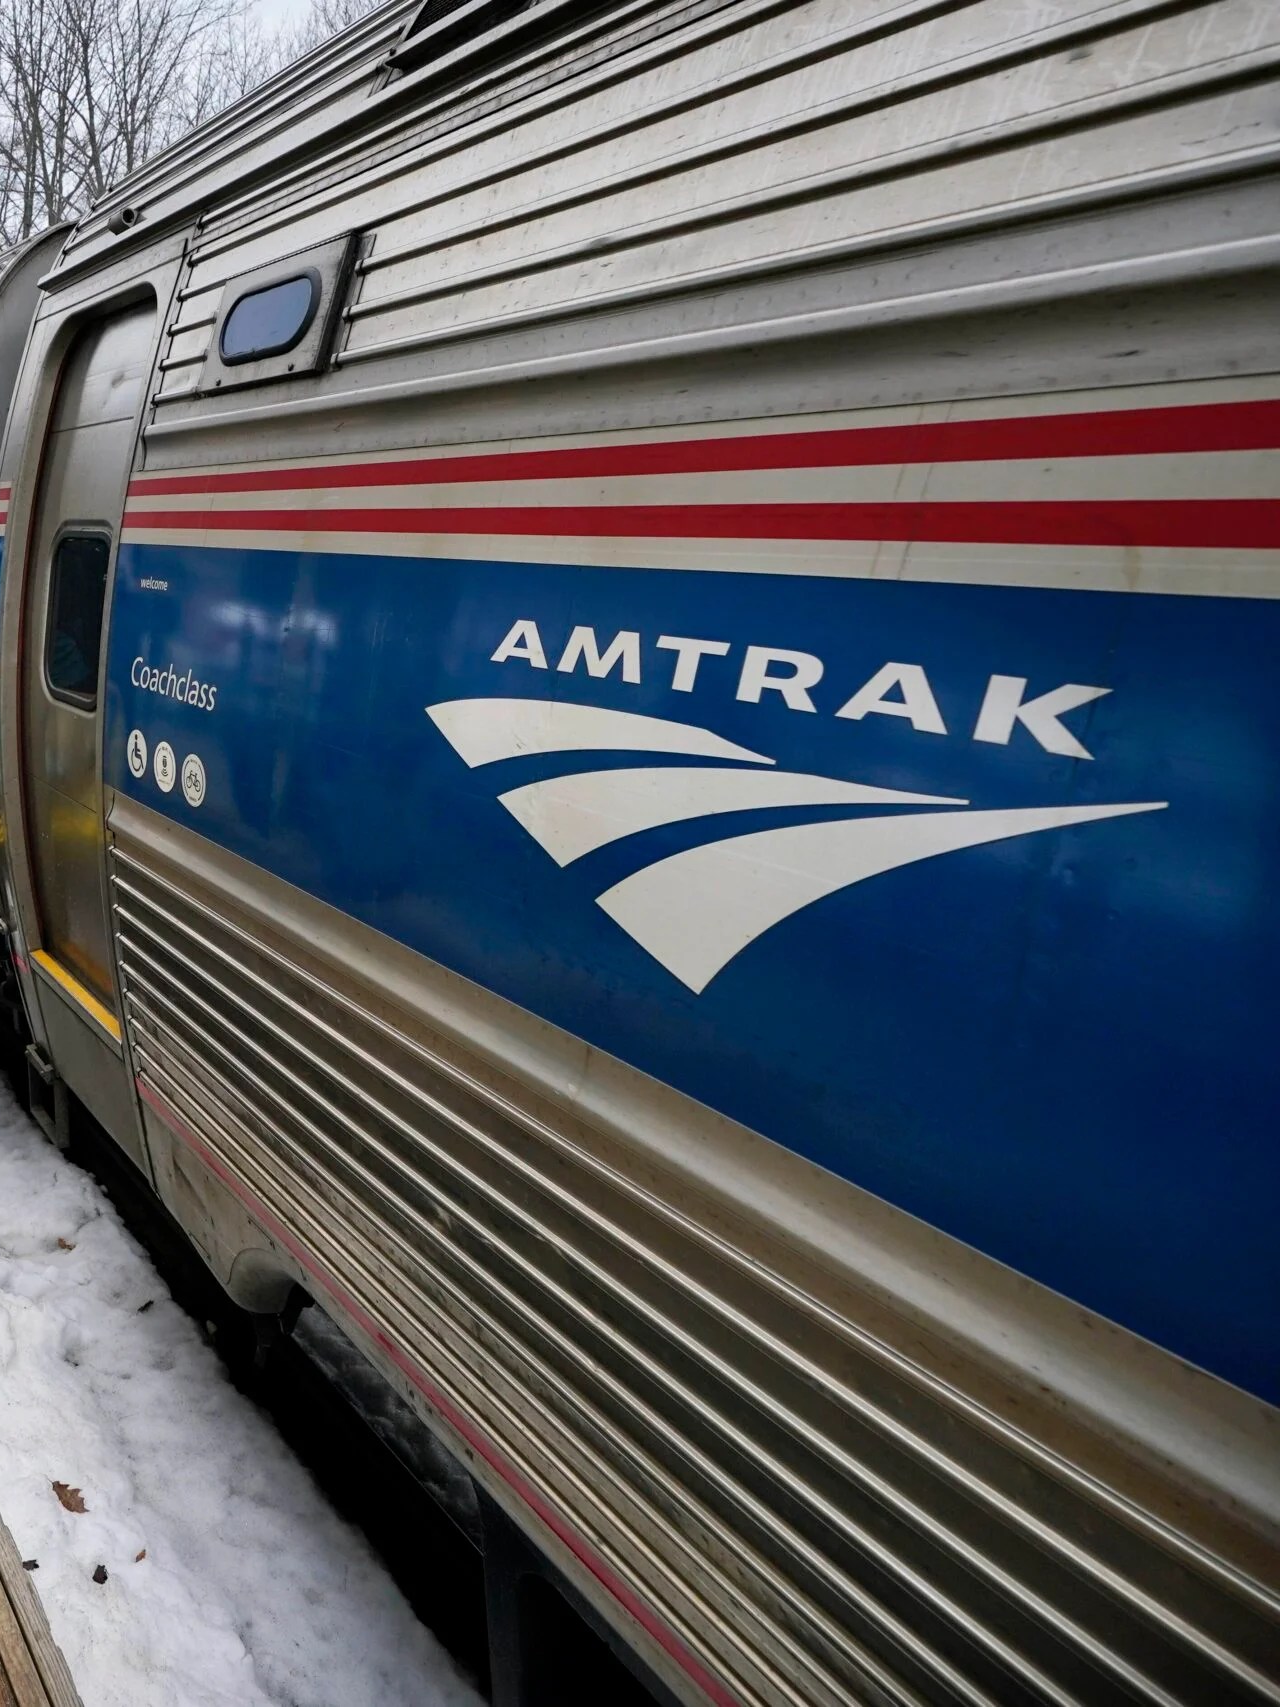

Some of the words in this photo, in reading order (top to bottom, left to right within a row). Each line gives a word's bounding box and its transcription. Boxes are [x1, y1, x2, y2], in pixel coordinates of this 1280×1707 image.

[140, 577, 169, 591] welcome
[131, 657, 218, 711] Coachclass
[490, 620, 1114, 760] AMTRAK
